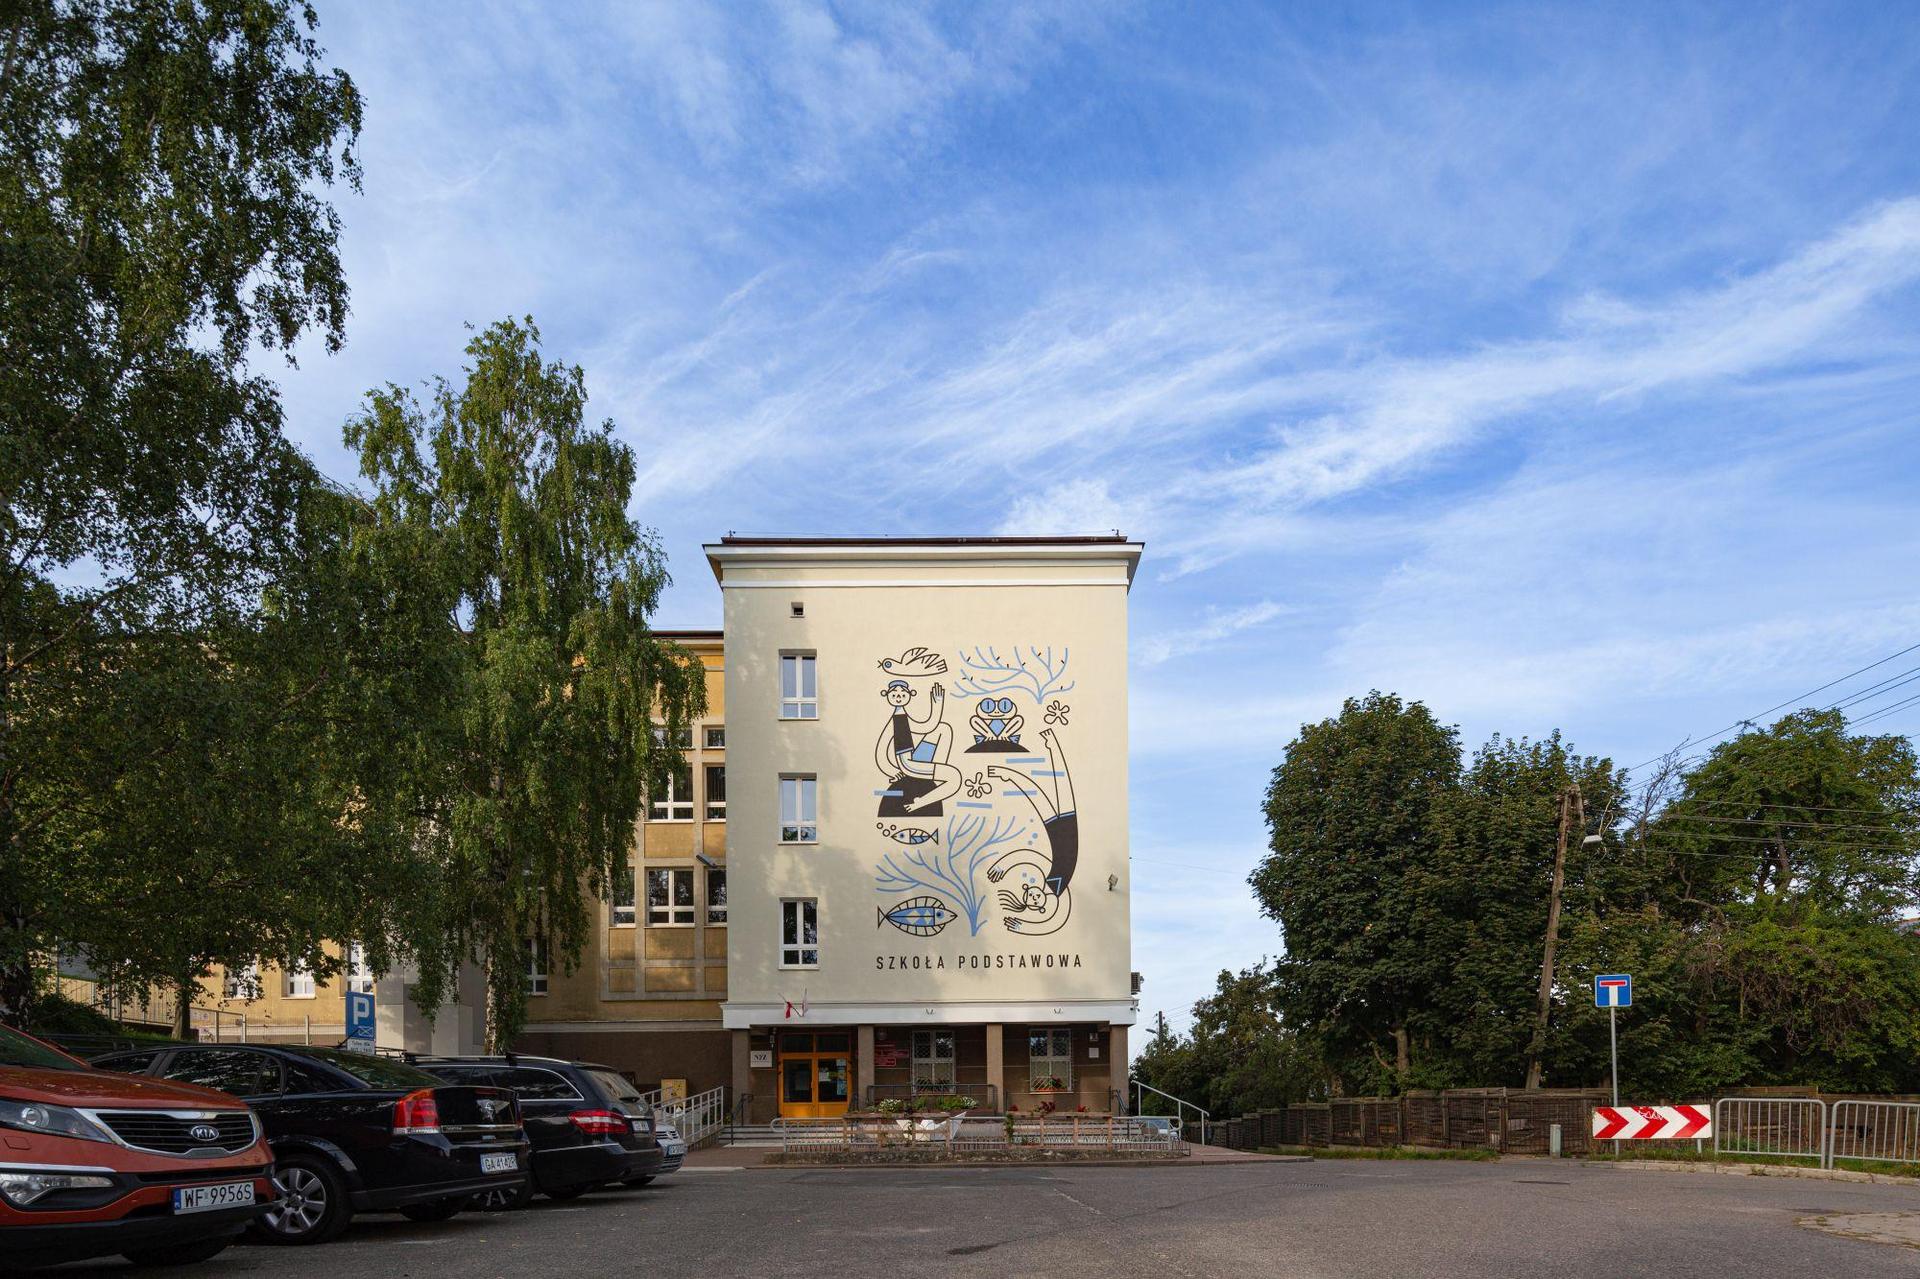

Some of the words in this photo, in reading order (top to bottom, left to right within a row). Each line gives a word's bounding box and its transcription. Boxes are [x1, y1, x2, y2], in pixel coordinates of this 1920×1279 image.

[876, 955, 945, 970] SZKOŁA
[958, 954, 1082, 969] PODSTAWOWA
[353, 996, 370, 1025] P
[195, 1128, 216, 1138] KIA
[184, 1188, 205, 1208] WF
[210, 1183, 252, 1205] 9956S
